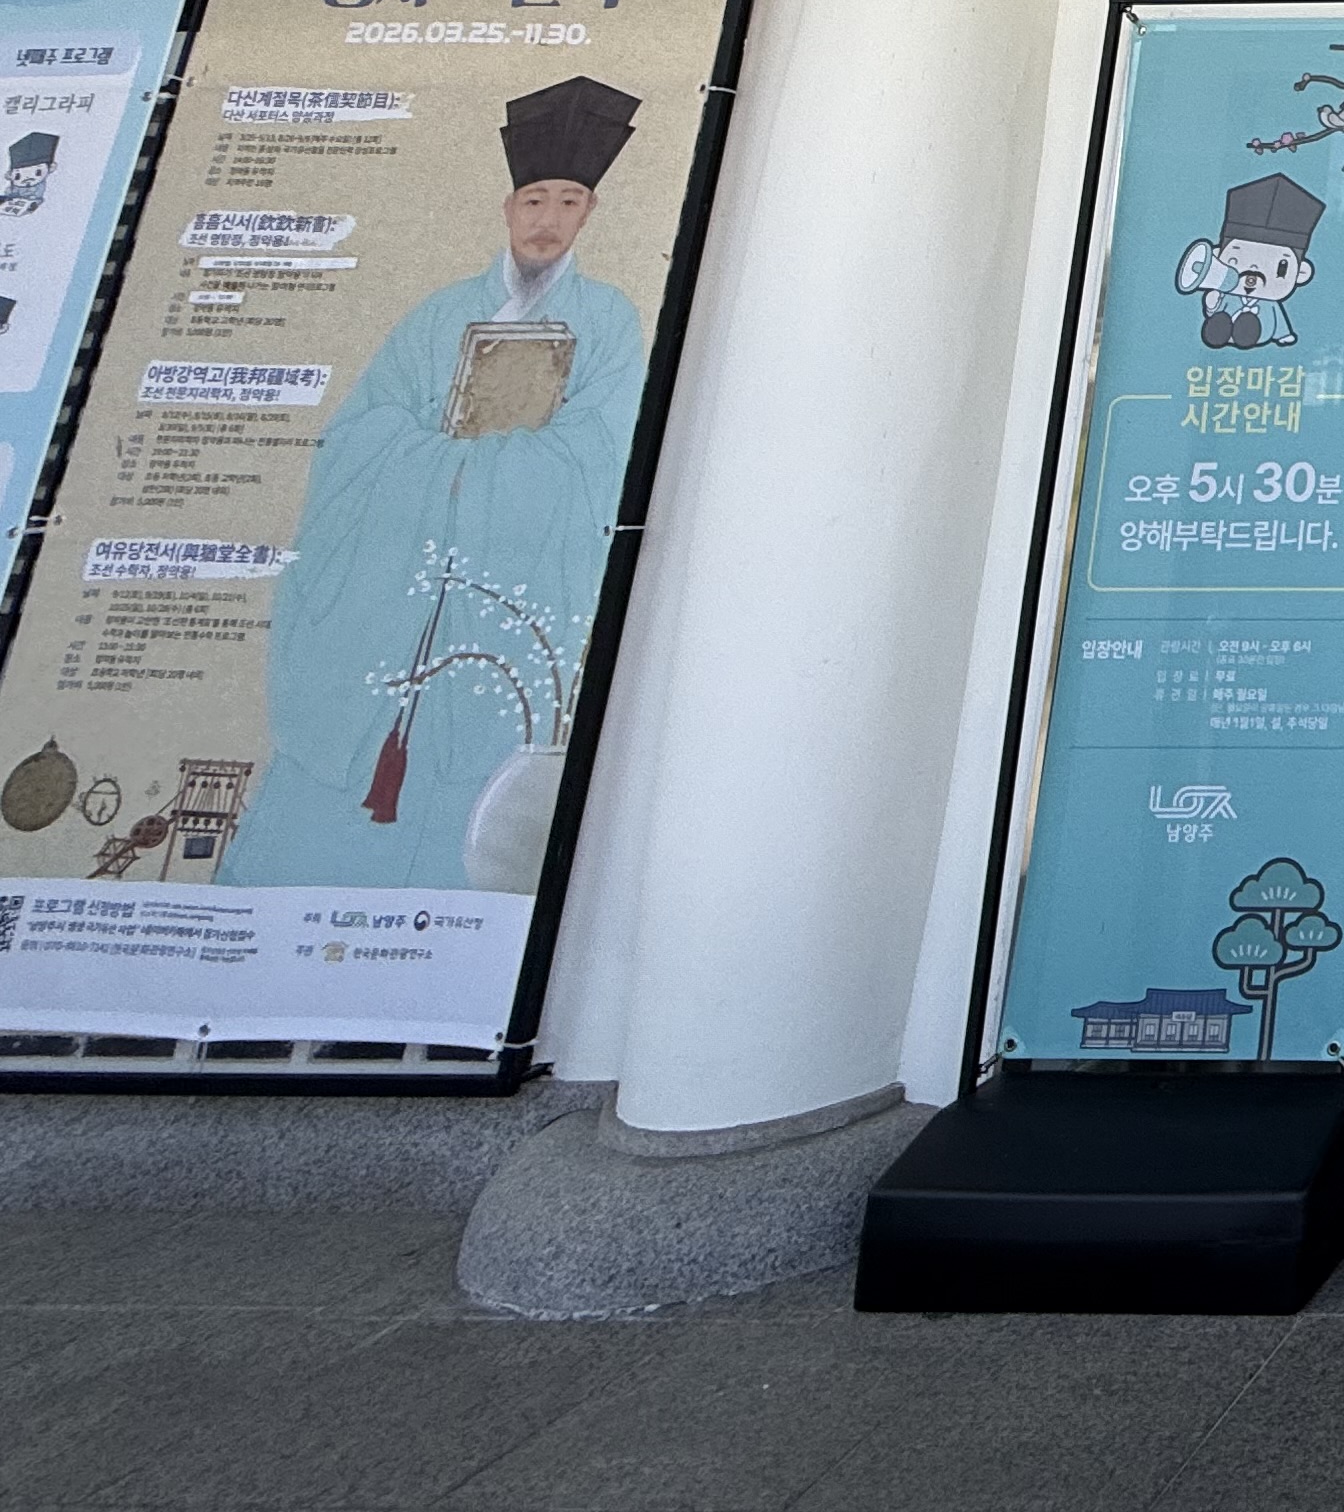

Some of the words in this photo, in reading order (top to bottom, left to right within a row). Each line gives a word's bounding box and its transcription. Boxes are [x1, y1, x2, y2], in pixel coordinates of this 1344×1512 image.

[60, 47, 114, 65] 프로그램
[223, 109, 245, 121] 다산
[248, 110, 289, 122] 서포터스
[188, 233, 208, 245] 조선
[1186, 365, 1306, 398] 입장마감
[140, 386, 162, 400] 조선
[1181, 401, 1301, 434] 시간안내
[1124, 473, 1181, 505] 오후
[1189, 462, 1245, 505] 5시
[1253, 462, 1343, 505] 30분
[1120, 519, 1339, 552] 양해부탁드립니다.
[89, 563, 115, 577] 조선
[1082, 639, 1143, 659] 입장안내
[1218, 640, 1240, 653] 오전
[1269, 640, 1290, 653] 오후
[1166, 823, 1213, 843] 남양주
[372, 914, 406, 928] 남양주
